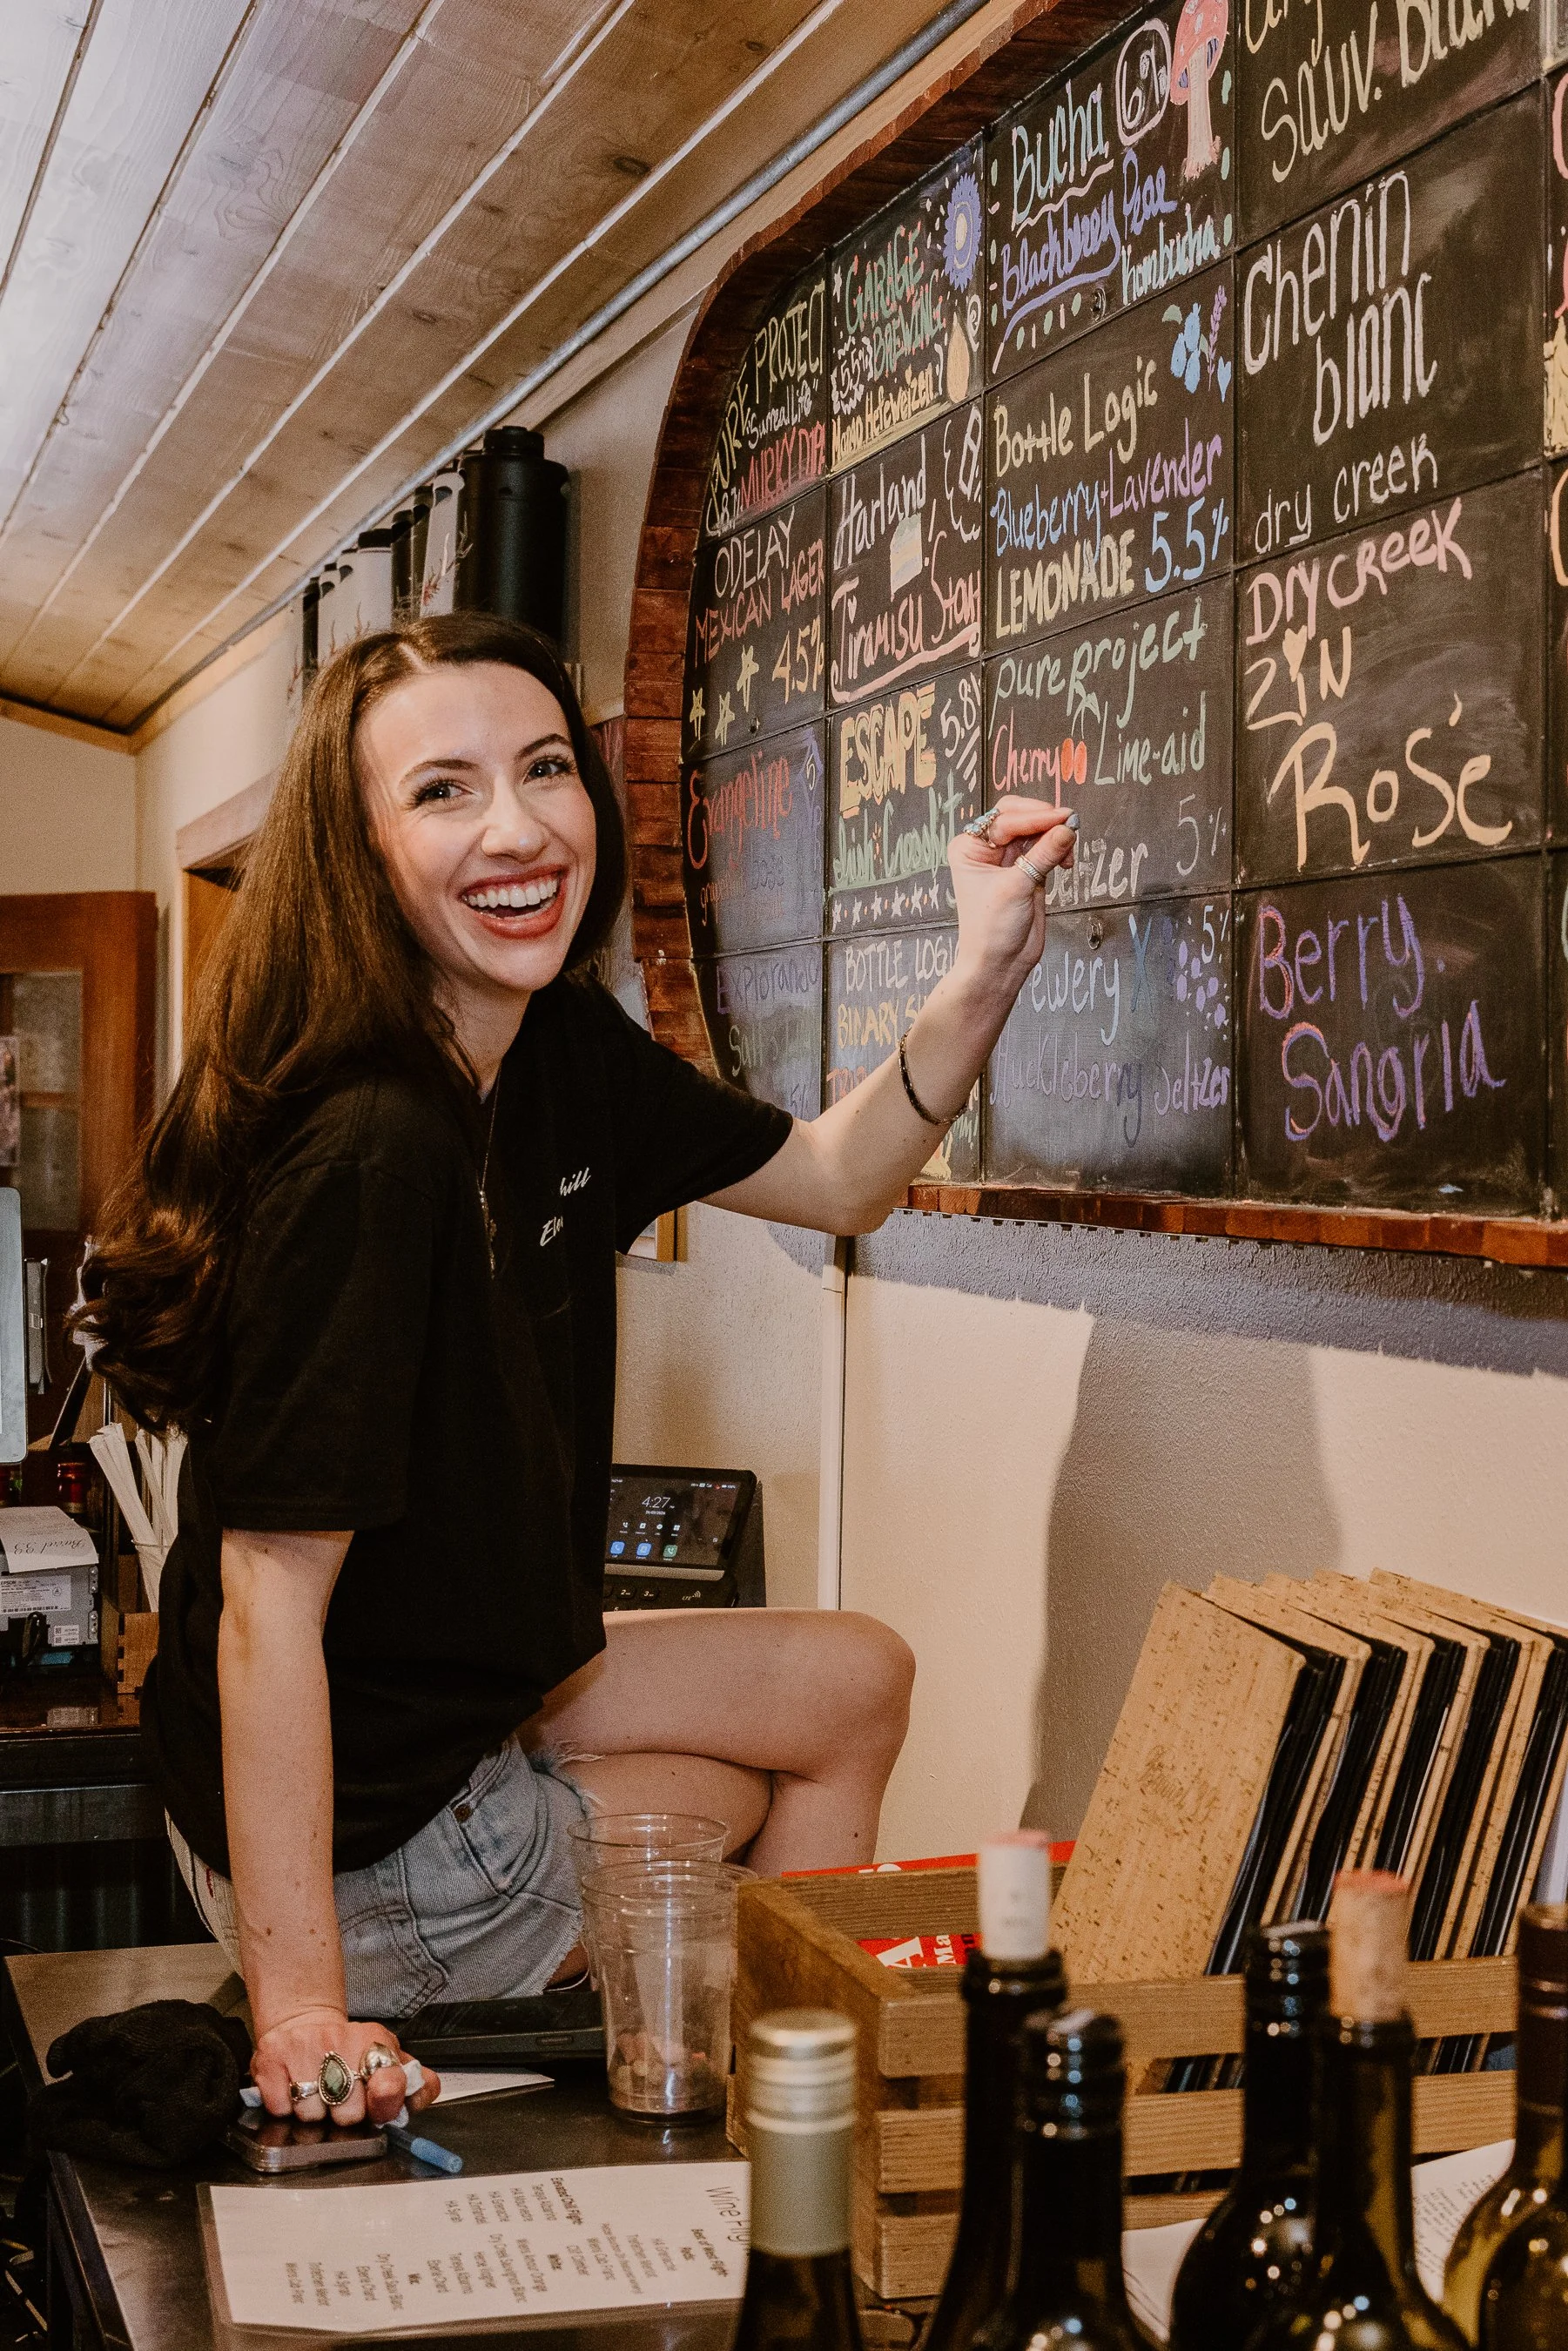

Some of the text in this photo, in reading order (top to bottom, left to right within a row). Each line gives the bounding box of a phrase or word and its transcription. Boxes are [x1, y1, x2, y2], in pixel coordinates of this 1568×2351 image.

[1012, 79, 1109, 232] Bucha
[846, 221, 924, 335] GARAGE
[1001, 189, 1121, 335] Blackberry
[1121, 203, 1221, 306] Kombucha
[1244, 171, 1410, 374] Chenin
[754, 279, 825, 404] PROJECT
[873, 269, 946, 381] BREWING
[1314, 272, 1437, 446] blanc
[741, 426, 796, 512] MURKY
[994, 355, 1158, 477] Bottle Logic
[714, 505, 794, 598] ODELAY
[833, 434, 926, 569] Harland
[990, 481, 1100, 564] Blueberry
[1255, 484, 1311, 554] dry
[695, 538, 824, 668] MEXICAN LAGER
[996, 497, 1229, 638] LEMONADE 5.5%
[772, 615, 824, 704] 4.5%
[839, 682, 937, 818] ESCAPE
[993, 707, 1061, 808] Cherry
[687, 750, 792, 869] Evangeline
[1045, 794, 1226, 906] eltzer 5%
[845, 935, 958, 994] BOTTLE LOGI
[1022, 951, 1120, 1046] ewery
[1201, 905, 1230, 964] 5%
[838, 998, 900, 1048] BINARY
[1282, 999, 1506, 1142] Sangria
[560, 1167, 591, 1196] hill
[642, 1497, 670, 1508] 4:27
[705, 2185, 742, 2218] Wine
